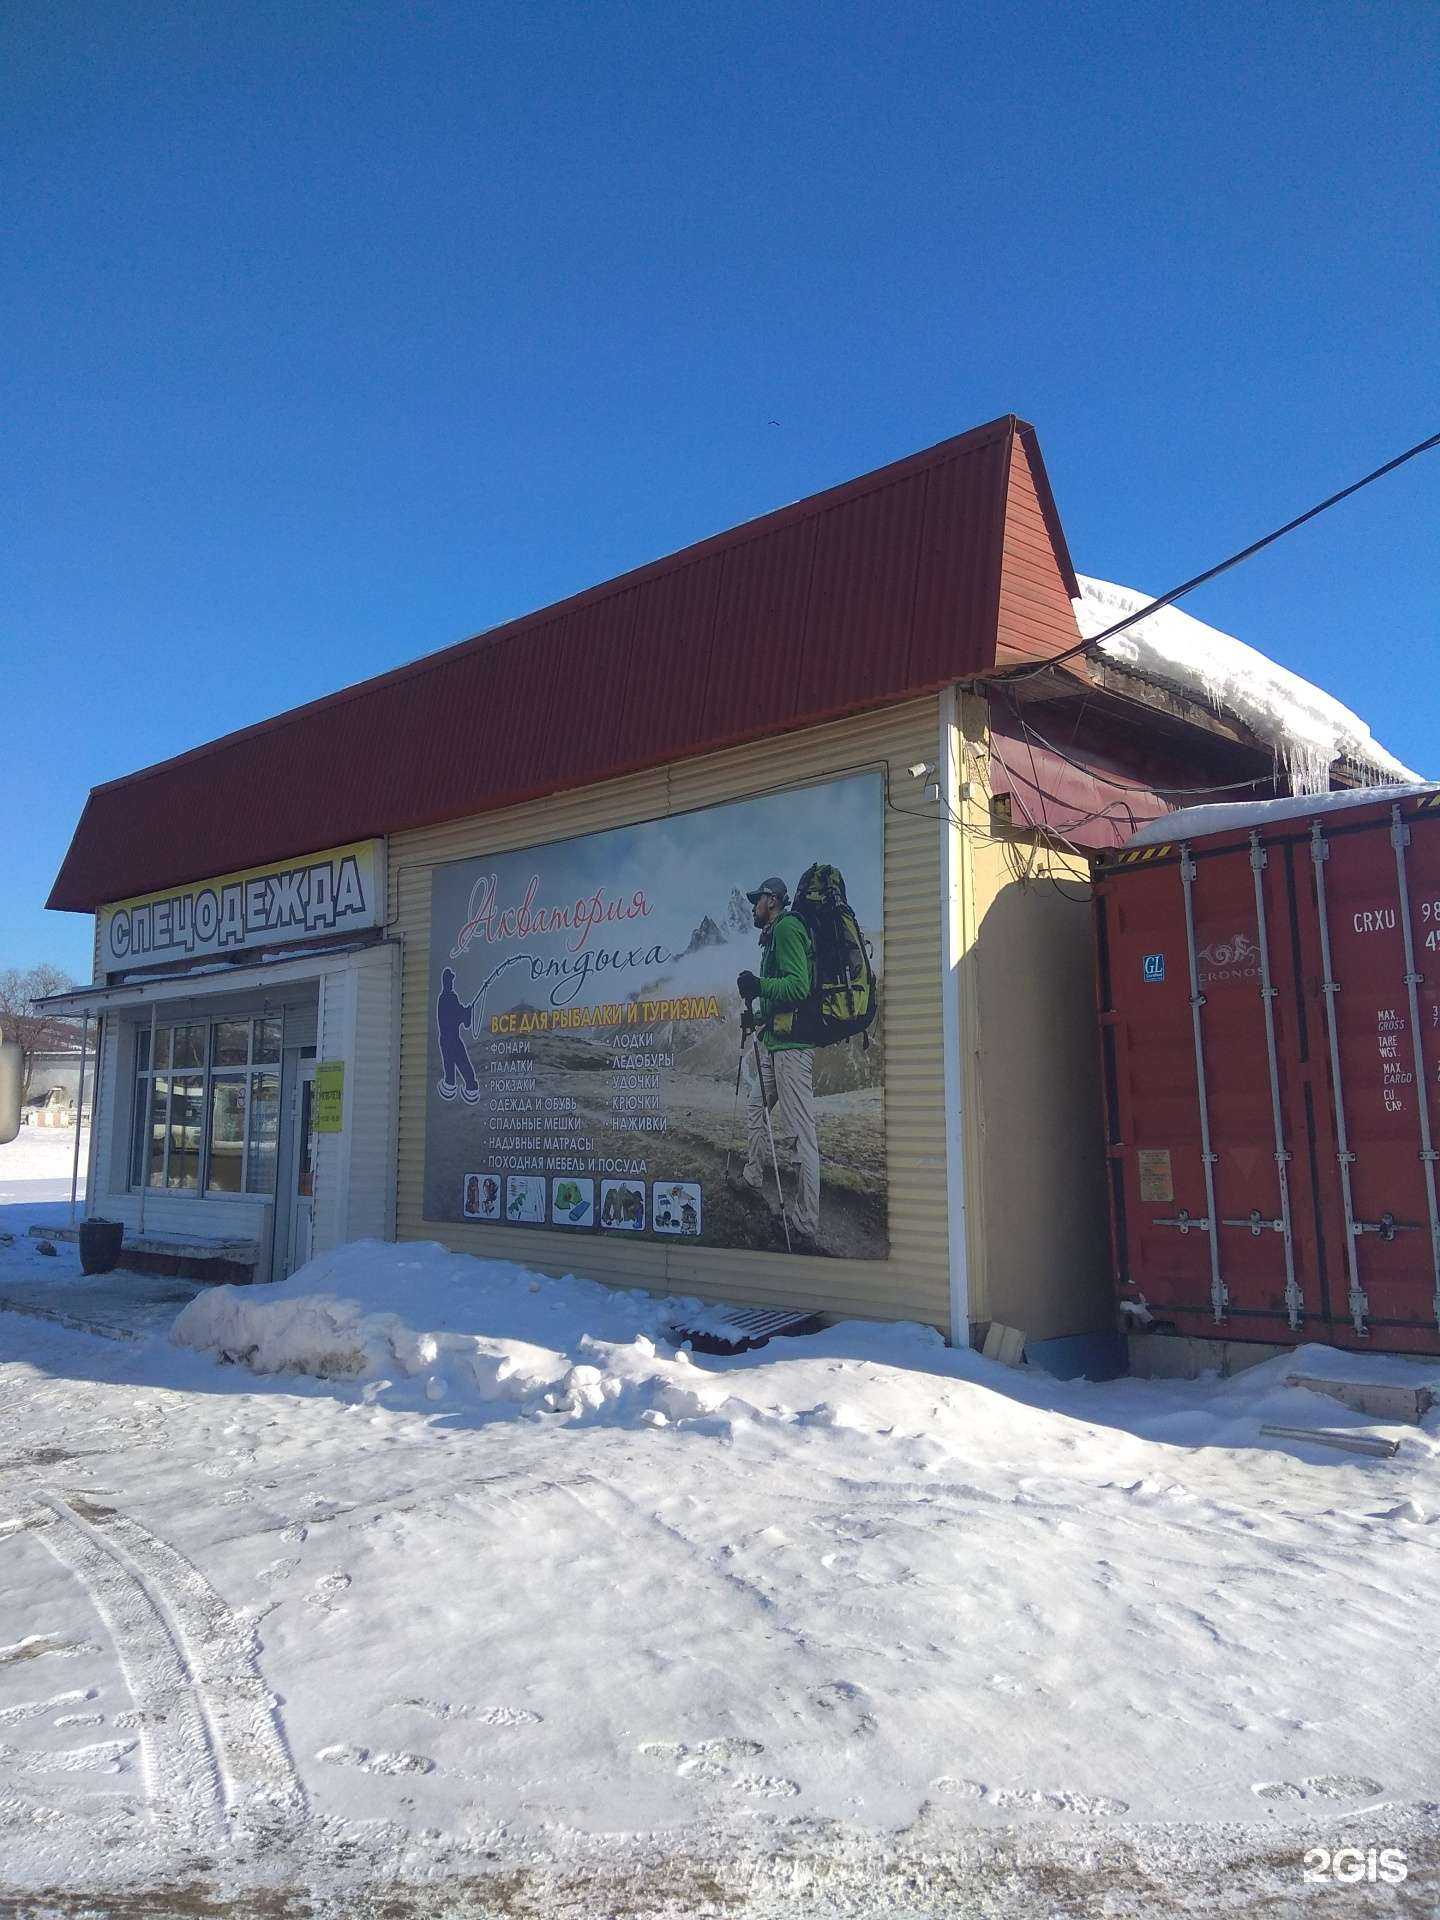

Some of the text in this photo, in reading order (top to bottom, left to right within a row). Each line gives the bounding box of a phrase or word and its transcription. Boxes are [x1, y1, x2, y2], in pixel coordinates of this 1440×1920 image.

[110, 854, 367, 959] СПЕЦОДЕЖДА
[450, 873, 654, 960] Акватория
[1353, 909, 1396, 933] CRXU
[529, 944, 671, 1006] отдыха
[490, 996, 720, 1034] ВСЕ ДЛЯ РЫБАЛКИ И ТУРИЗМА
[1378, 1020, 1405, 1032] GROSS
[490, 1040, 531, 1055] ФОНАРИ
[612, 1032, 654, 1050] ЛОДКИ
[1378, 1035, 1399, 1047] TARE
[490, 1060, 534, 1074] ПАЛАТКИ
[612, 1052, 675, 1070] ЛЕДОБУРЫ
[490, 1079, 537, 1093] РЮКЗАКИ
[612, 1074, 660, 1091] УДОЧКИ
[1383, 1073, 1412, 1084] CARGO
[489, 1097, 577, 1113] ОДЕЖДА И ОБУВЬ
[612, 1095, 660, 1112] КРЮЧКИ
[489, 1117, 582, 1131] СПАЛЬНЫЕ МЕШКИ
[612, 1116, 667, 1132] НАЖИВКИ
[488, 1136, 594, 1152] НАДУВНЫЕ МАТРАСЫ
[487, 1155, 648, 1175] ПОХОДНАЯ МЕБЕЛЬ И ПОСУДА
